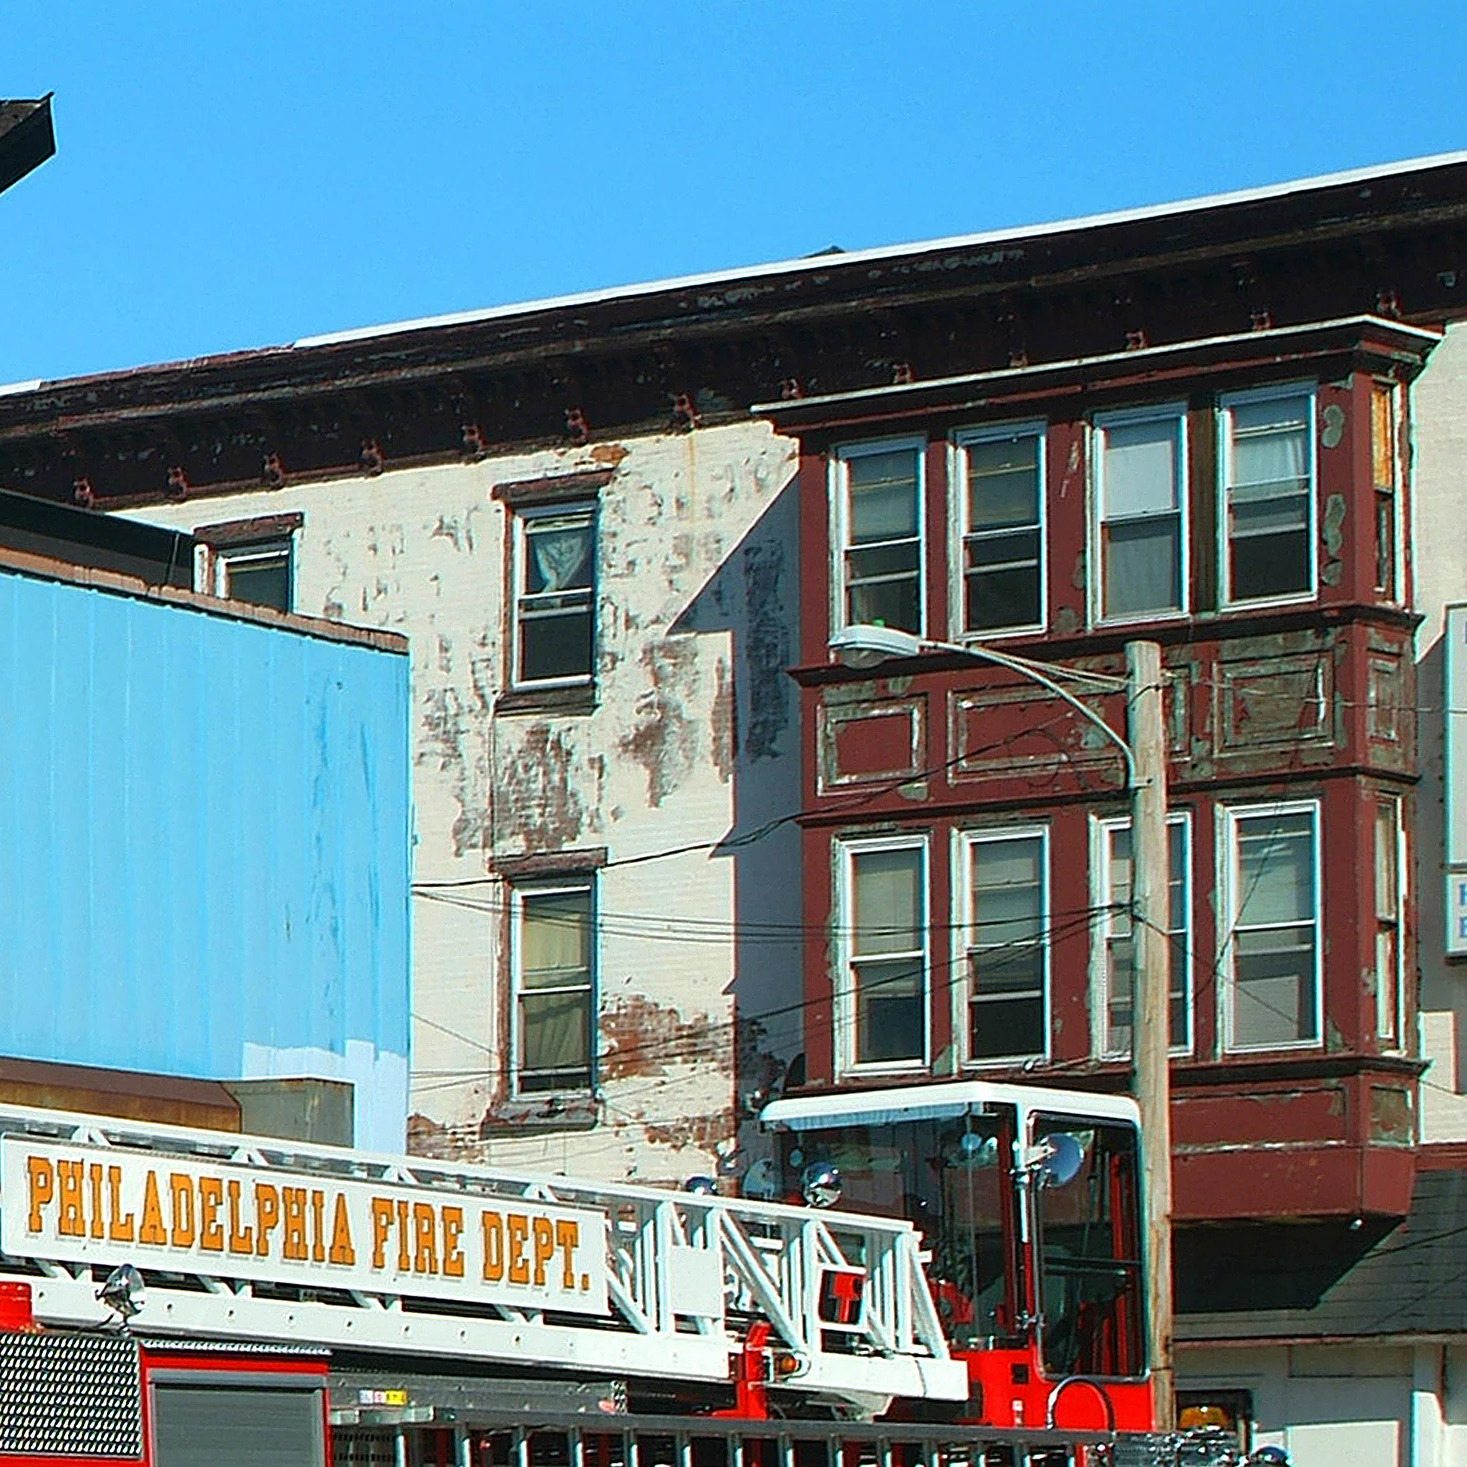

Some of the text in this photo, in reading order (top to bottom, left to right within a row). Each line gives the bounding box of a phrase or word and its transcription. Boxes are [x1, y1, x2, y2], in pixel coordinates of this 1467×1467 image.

[28, 1155, 590, 1291] PHILADELPHIA FIRE DEPT.
